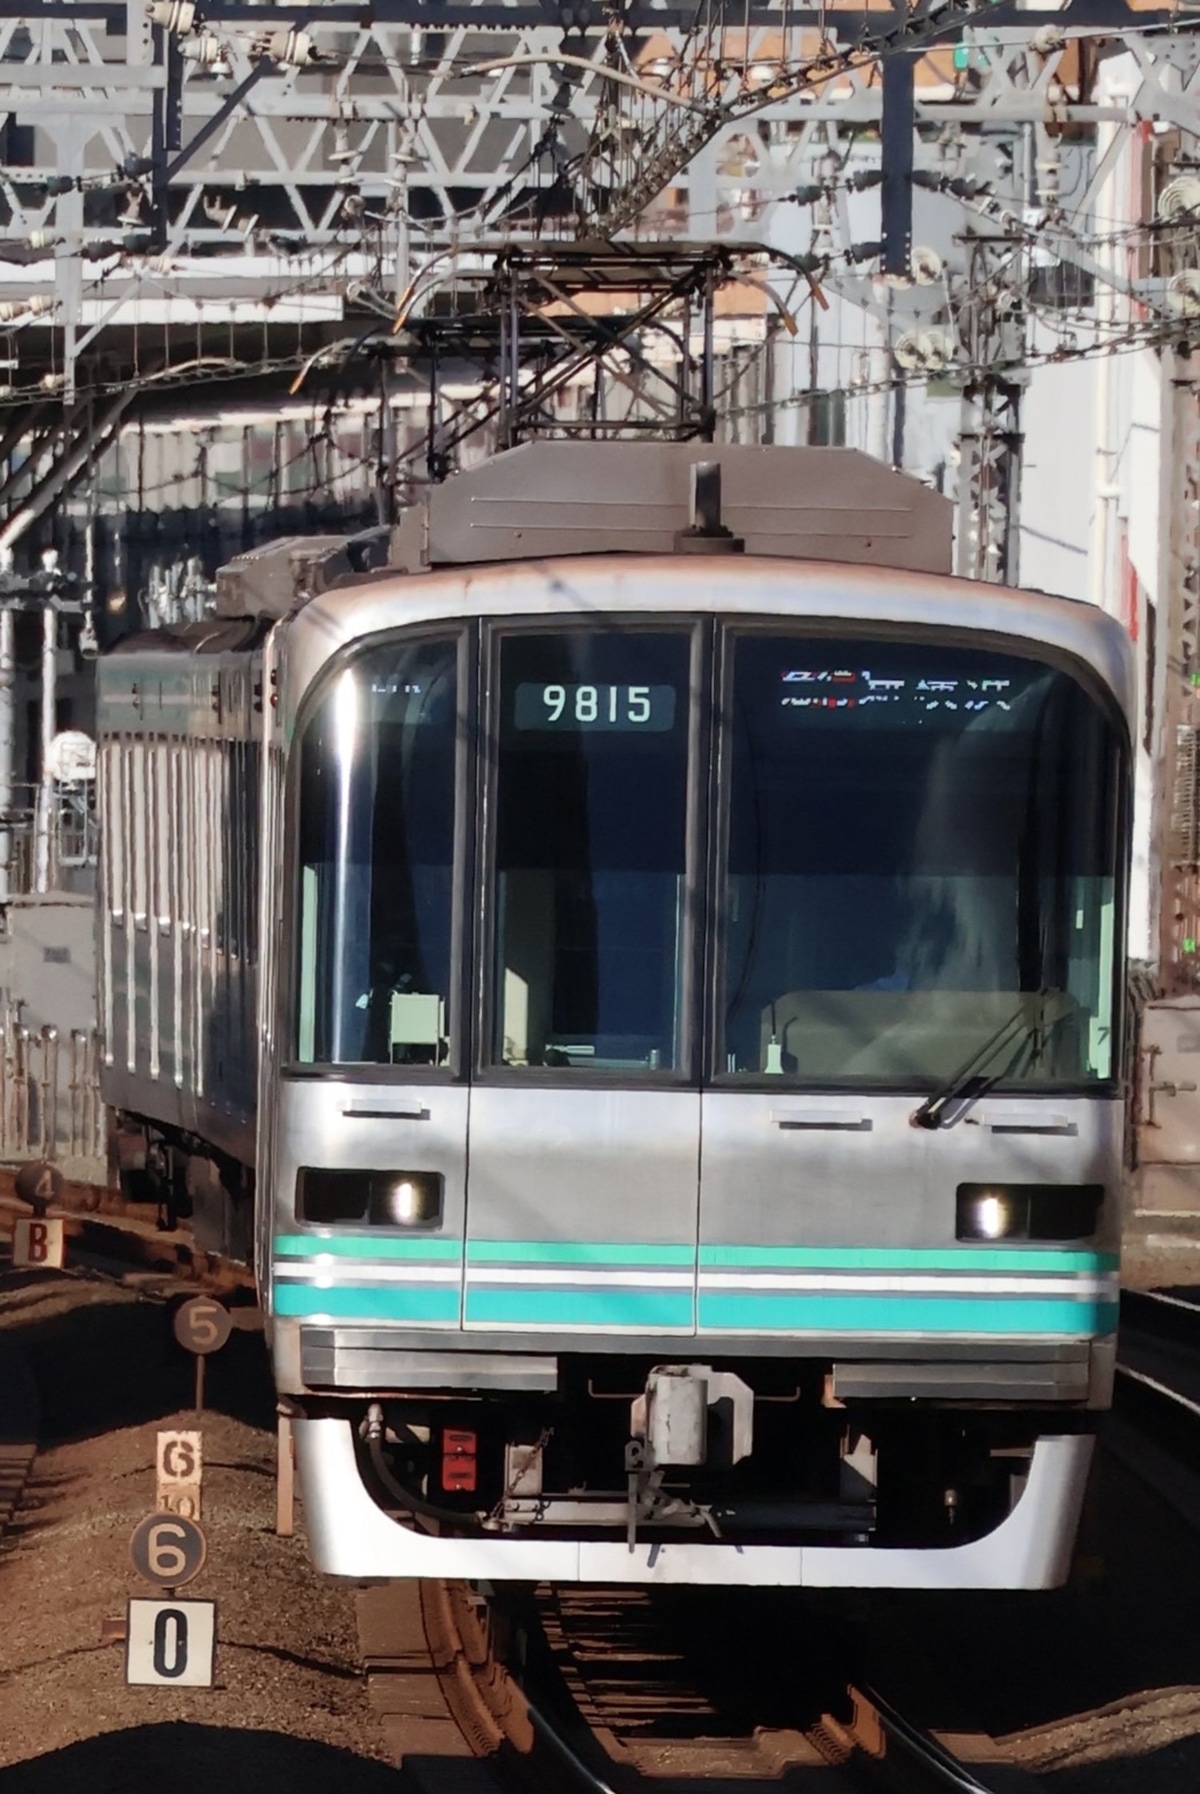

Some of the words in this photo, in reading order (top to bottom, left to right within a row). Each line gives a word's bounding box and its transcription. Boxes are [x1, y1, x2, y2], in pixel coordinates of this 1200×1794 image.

[543, 685, 651, 722] 9815
[35, 1170, 55, 1198] 4
[28, 1223, 48, 1263] B
[189, 1306, 218, 1345] 5
[163, 1440, 195, 1477] 6
[148, 1523, 187, 1577] 6
[153, 1608, 188, 1678] 0
